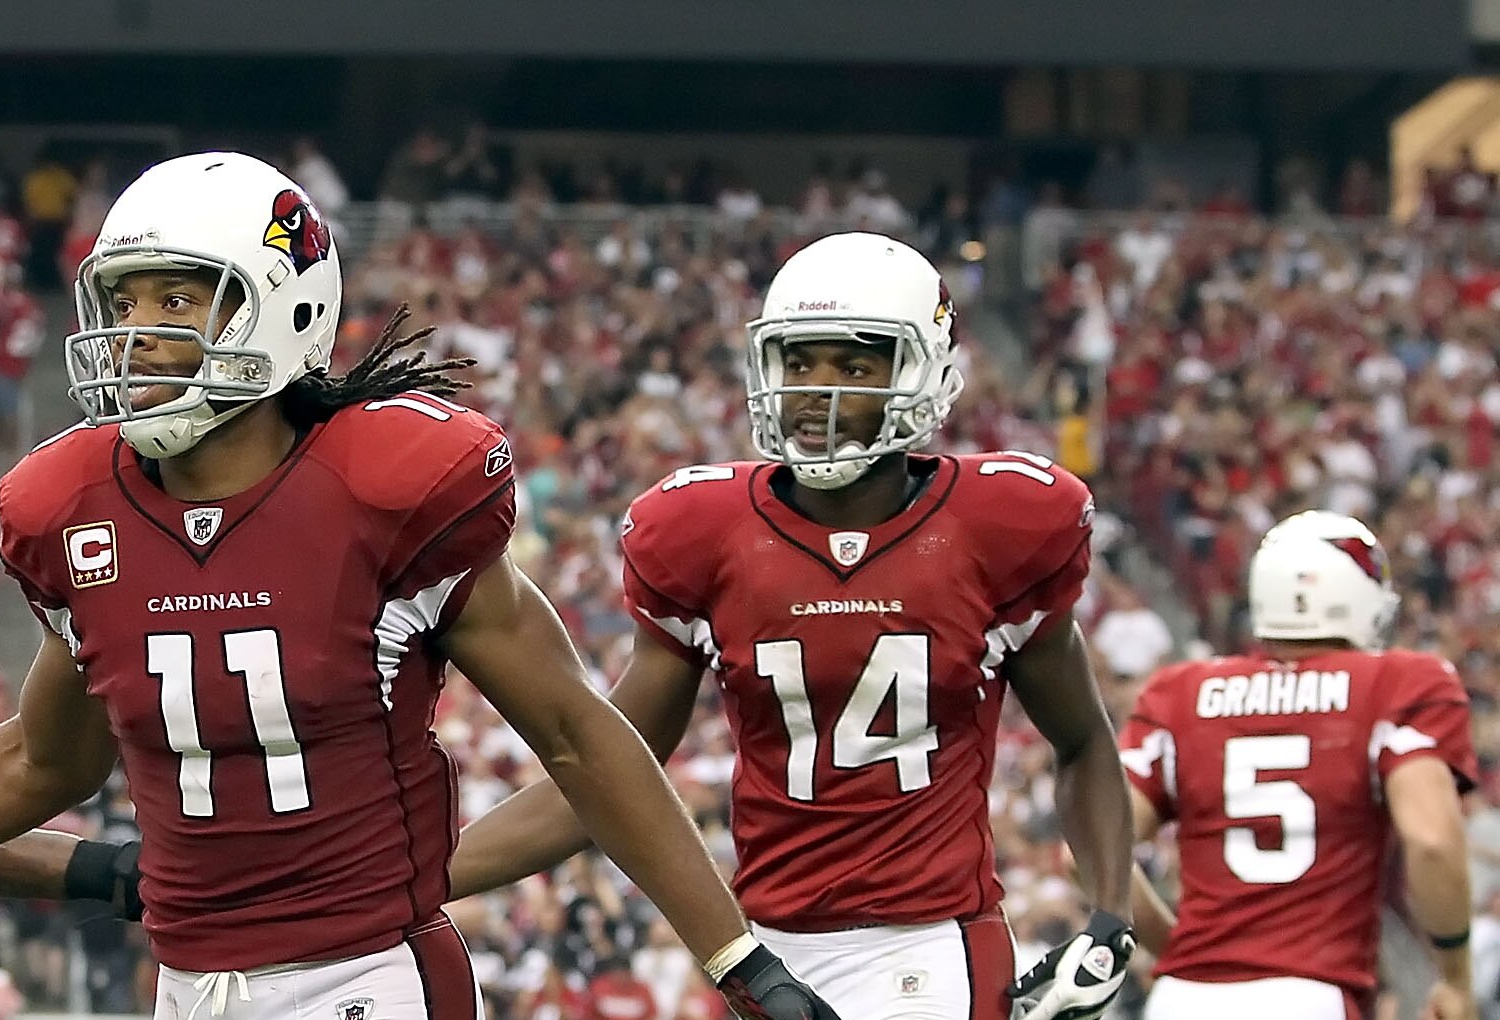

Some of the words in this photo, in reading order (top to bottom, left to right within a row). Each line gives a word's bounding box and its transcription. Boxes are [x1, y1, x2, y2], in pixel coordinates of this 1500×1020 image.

[798, 301, 837, 312] Riddell
[69, 527, 113, 572] C
[146, 591, 272, 613] CARDINALS
[789, 599, 904, 617] CARDINALS
[754, 633, 940, 802] 14
[1196, 670, 1350, 719] GRAHAM
[146, 627, 311, 818] 11
[1223, 734, 1317, 885] 5
